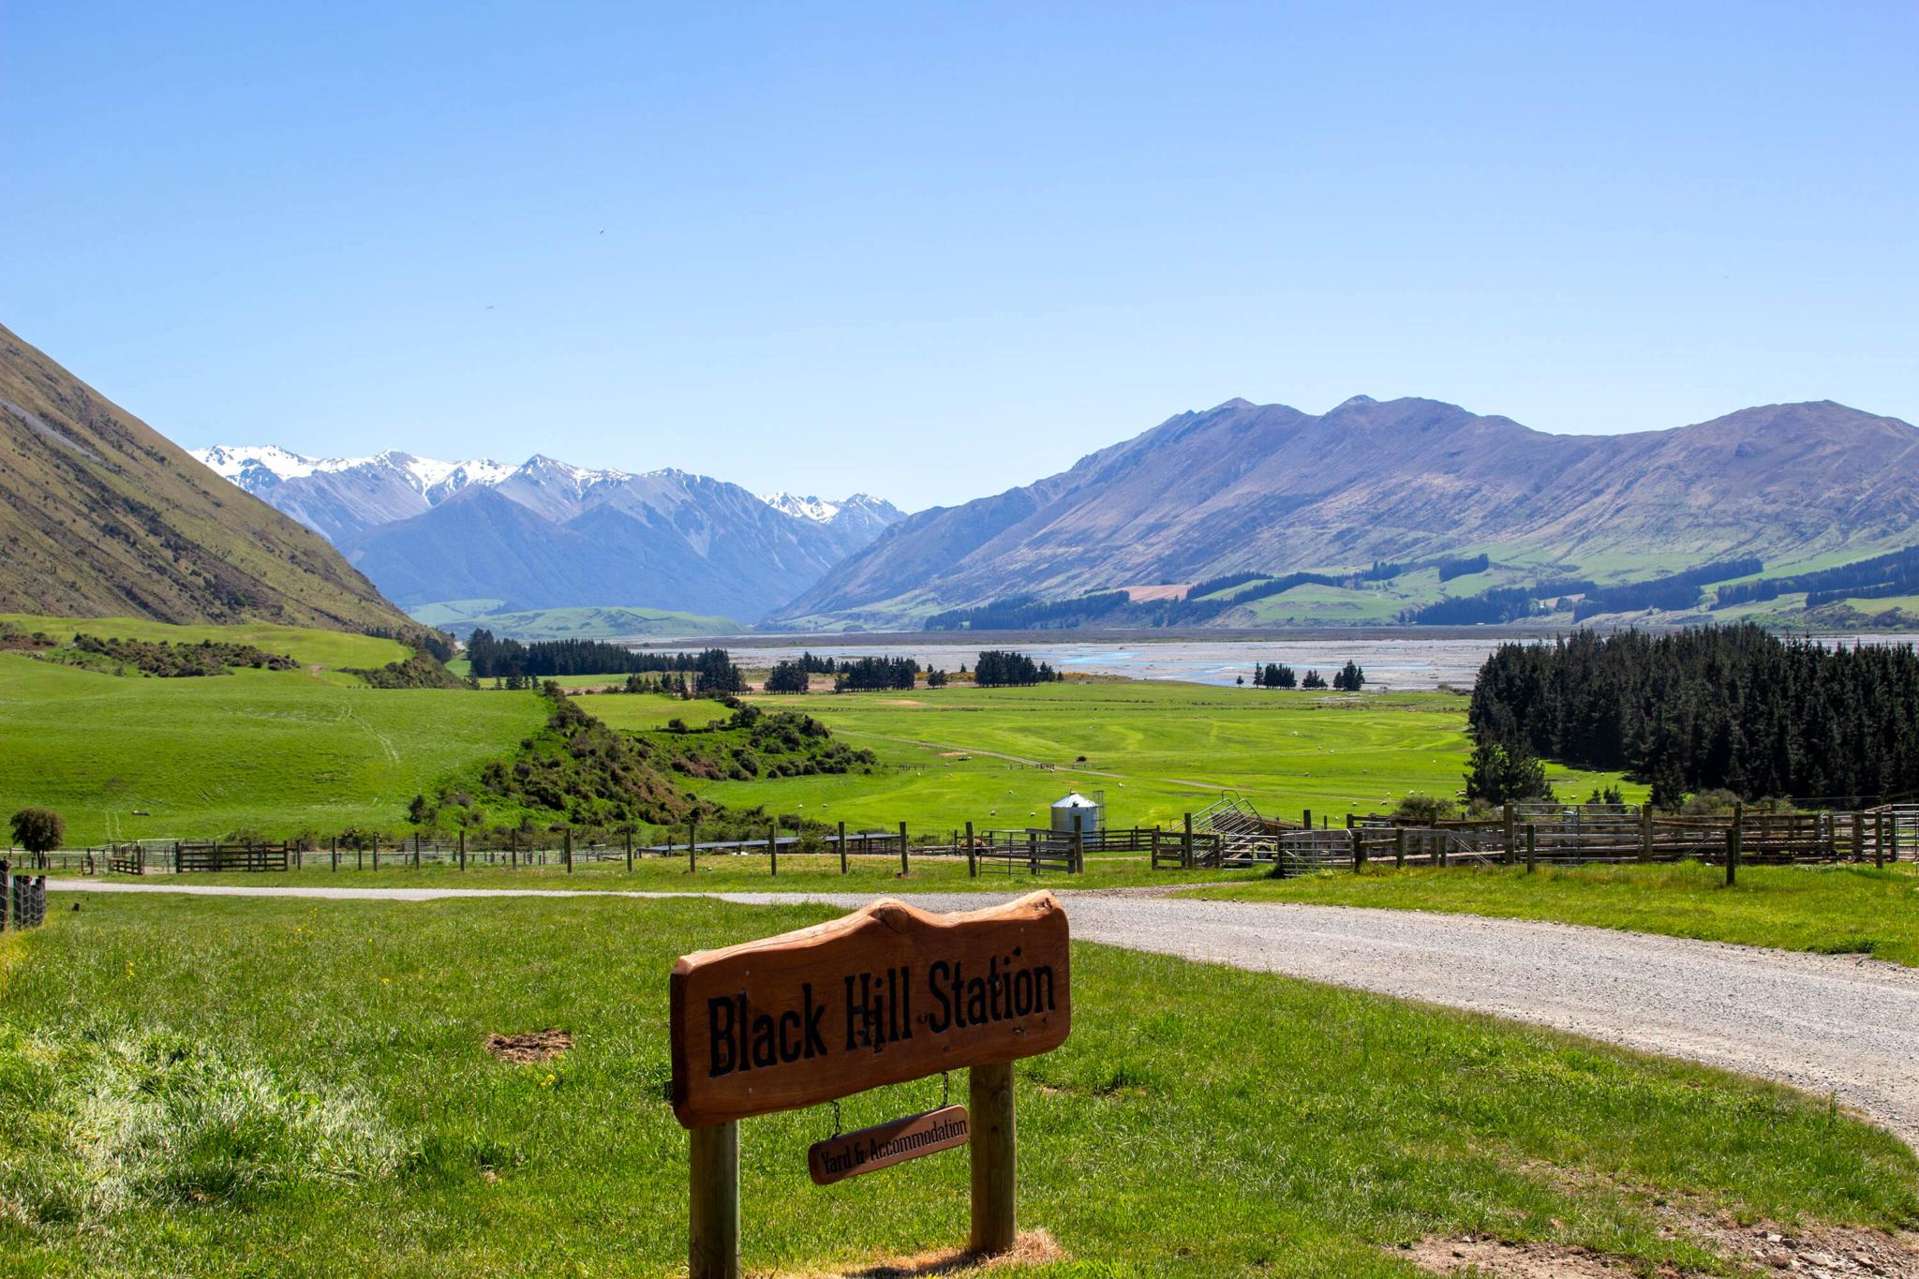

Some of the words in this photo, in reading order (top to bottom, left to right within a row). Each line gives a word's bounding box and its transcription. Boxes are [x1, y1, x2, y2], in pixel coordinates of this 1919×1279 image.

[707, 983, 828, 1078] Black
[845, 965, 913, 1051] Hill
[929, 955, 1056, 1034] Station
[821, 1147, 851, 1175] Yard
[870, 1119, 969, 1161] Accommodation
